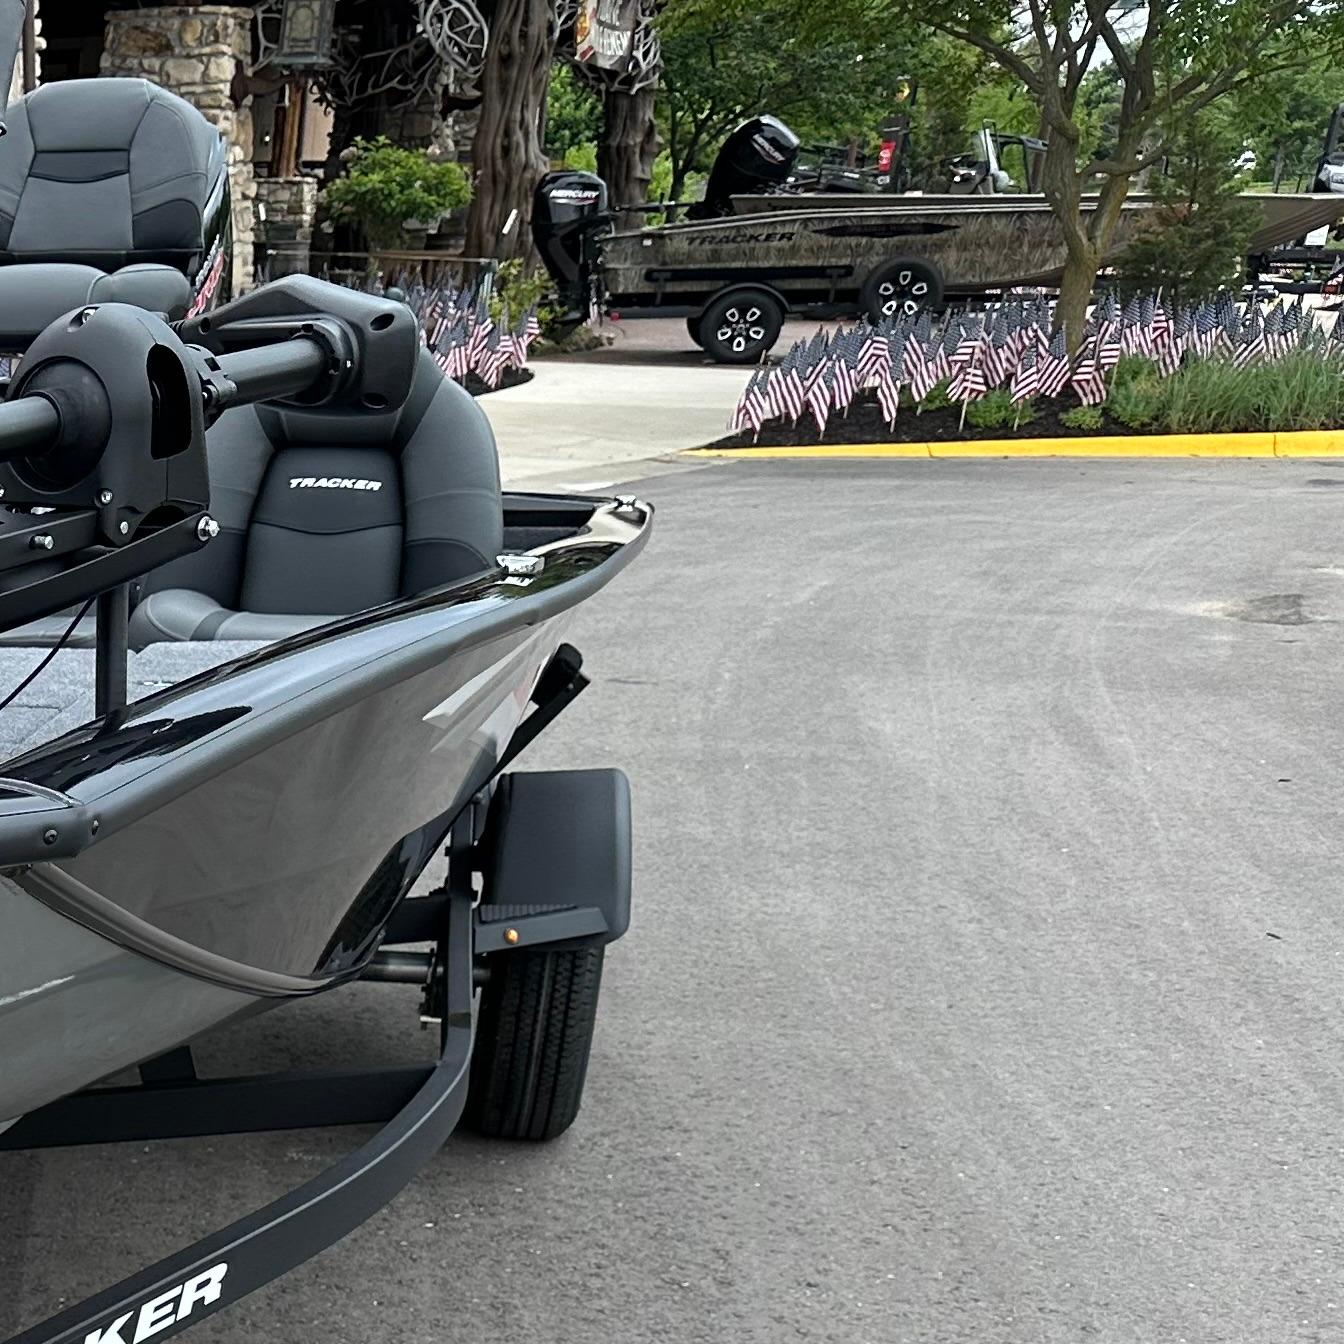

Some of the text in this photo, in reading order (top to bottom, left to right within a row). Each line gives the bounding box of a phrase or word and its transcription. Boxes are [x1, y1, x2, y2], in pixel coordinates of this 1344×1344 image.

[549, 189, 600, 199] MERCURY
[686, 231, 796, 246] TRACKER
[289, 477, 383, 492] TRACKER
